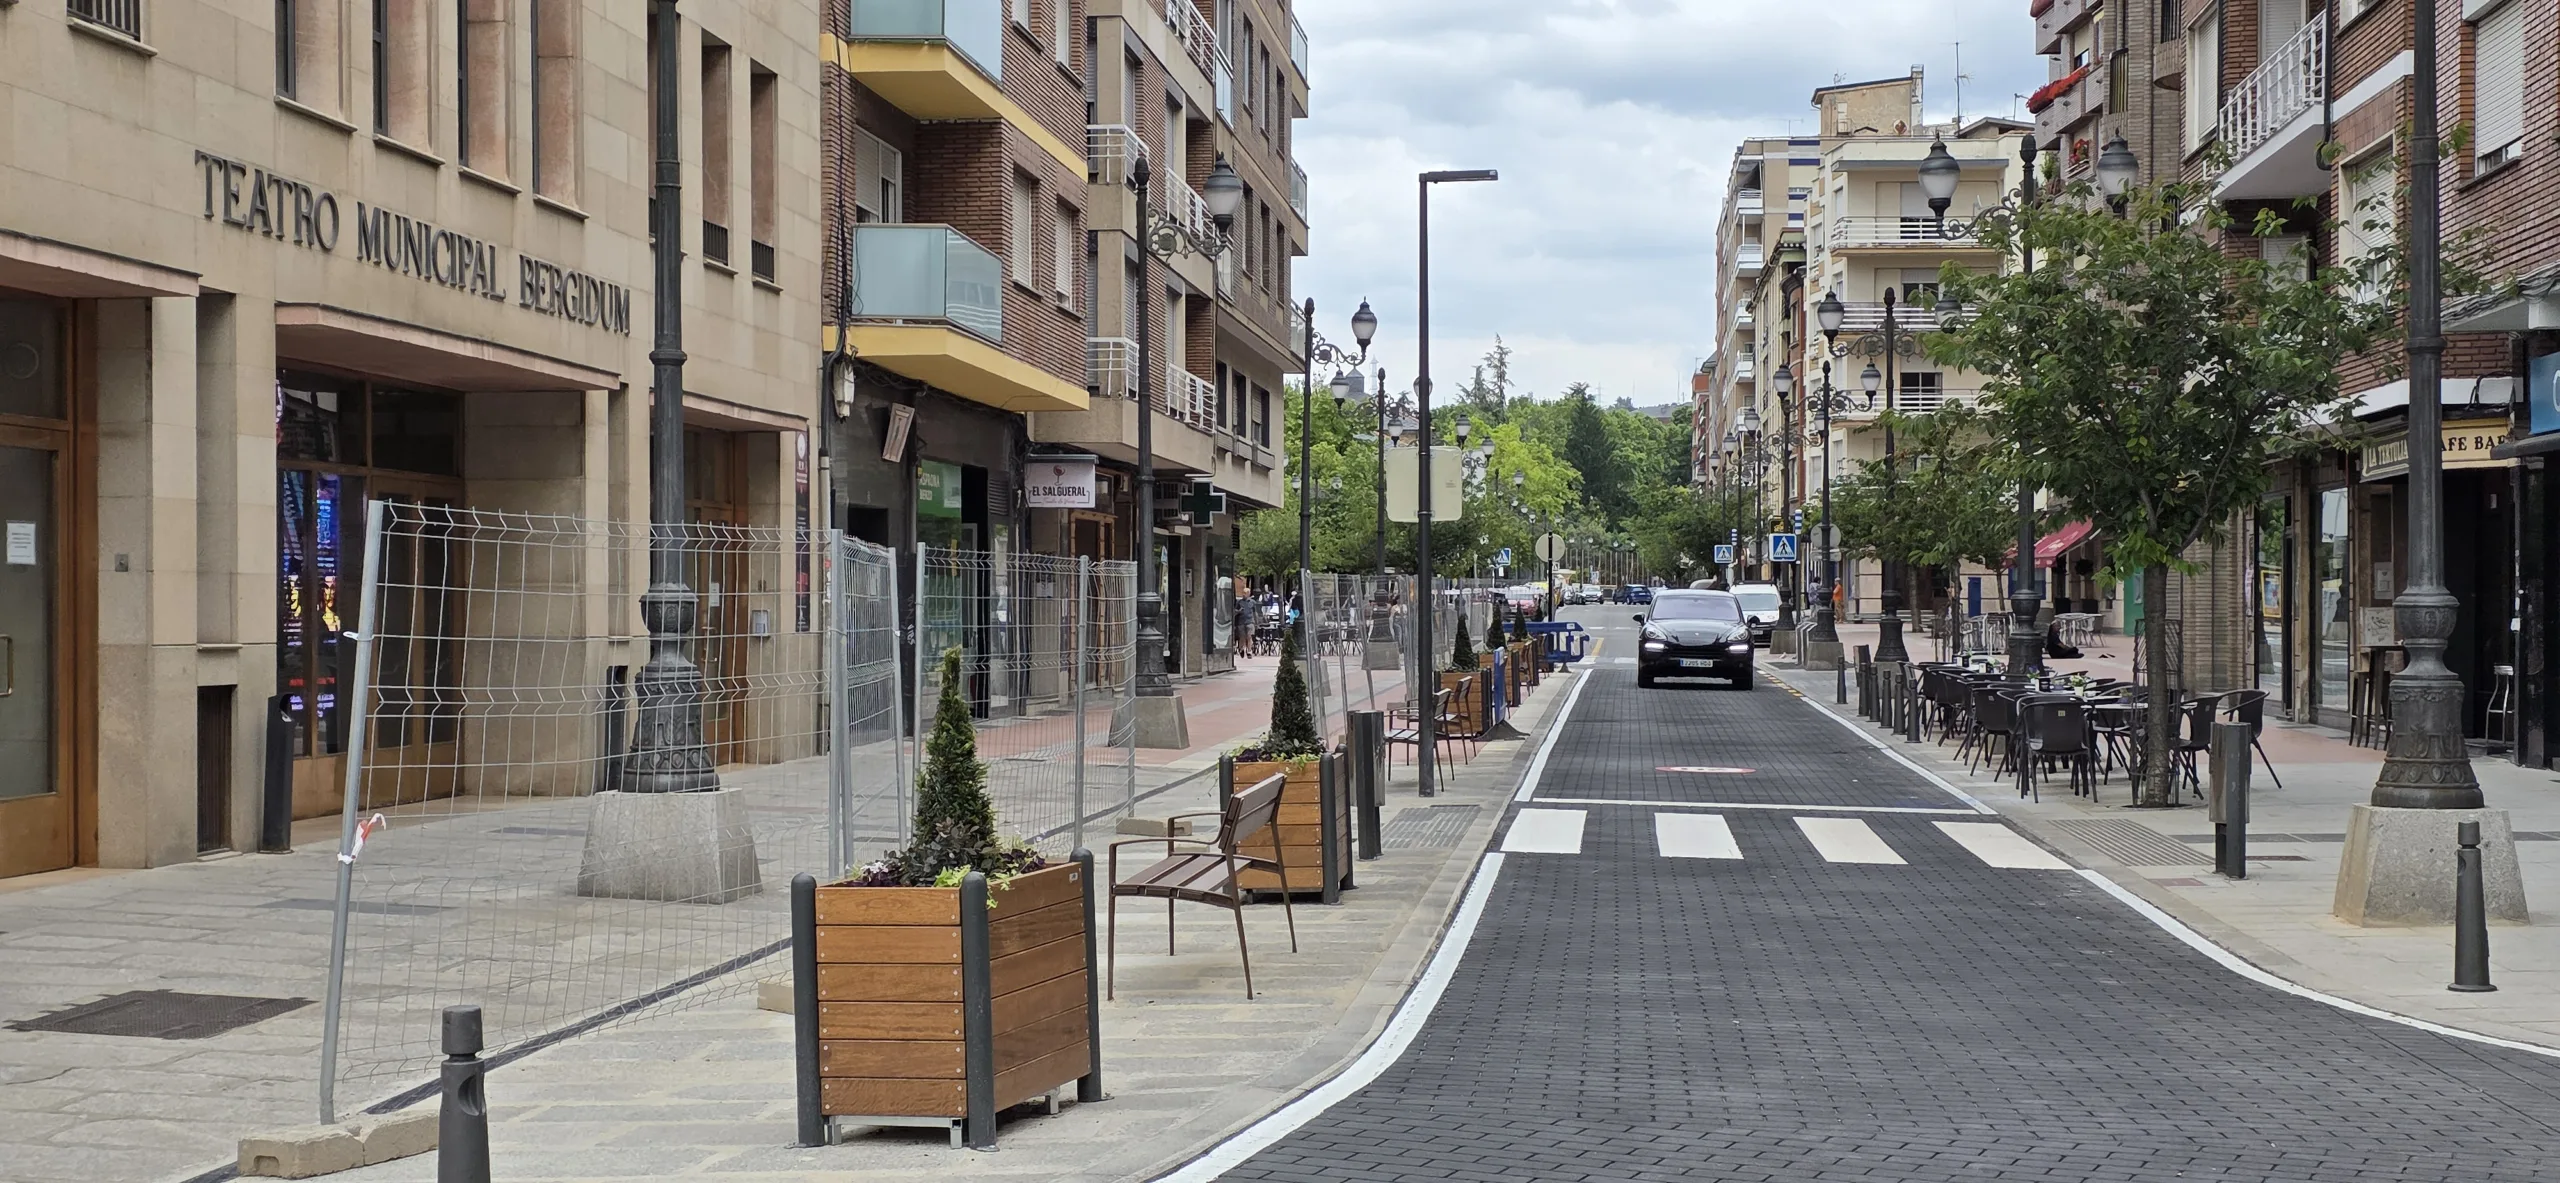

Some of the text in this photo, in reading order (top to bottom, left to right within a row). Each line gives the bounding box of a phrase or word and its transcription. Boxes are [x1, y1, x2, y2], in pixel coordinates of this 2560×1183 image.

[195, 149, 631, 337] TEATRO MUNICIPAL BERGIDUM
[2368, 439, 2409, 468] LA TERTULIA
[1032, 486, 1086, 496] EL SALGUERAL
